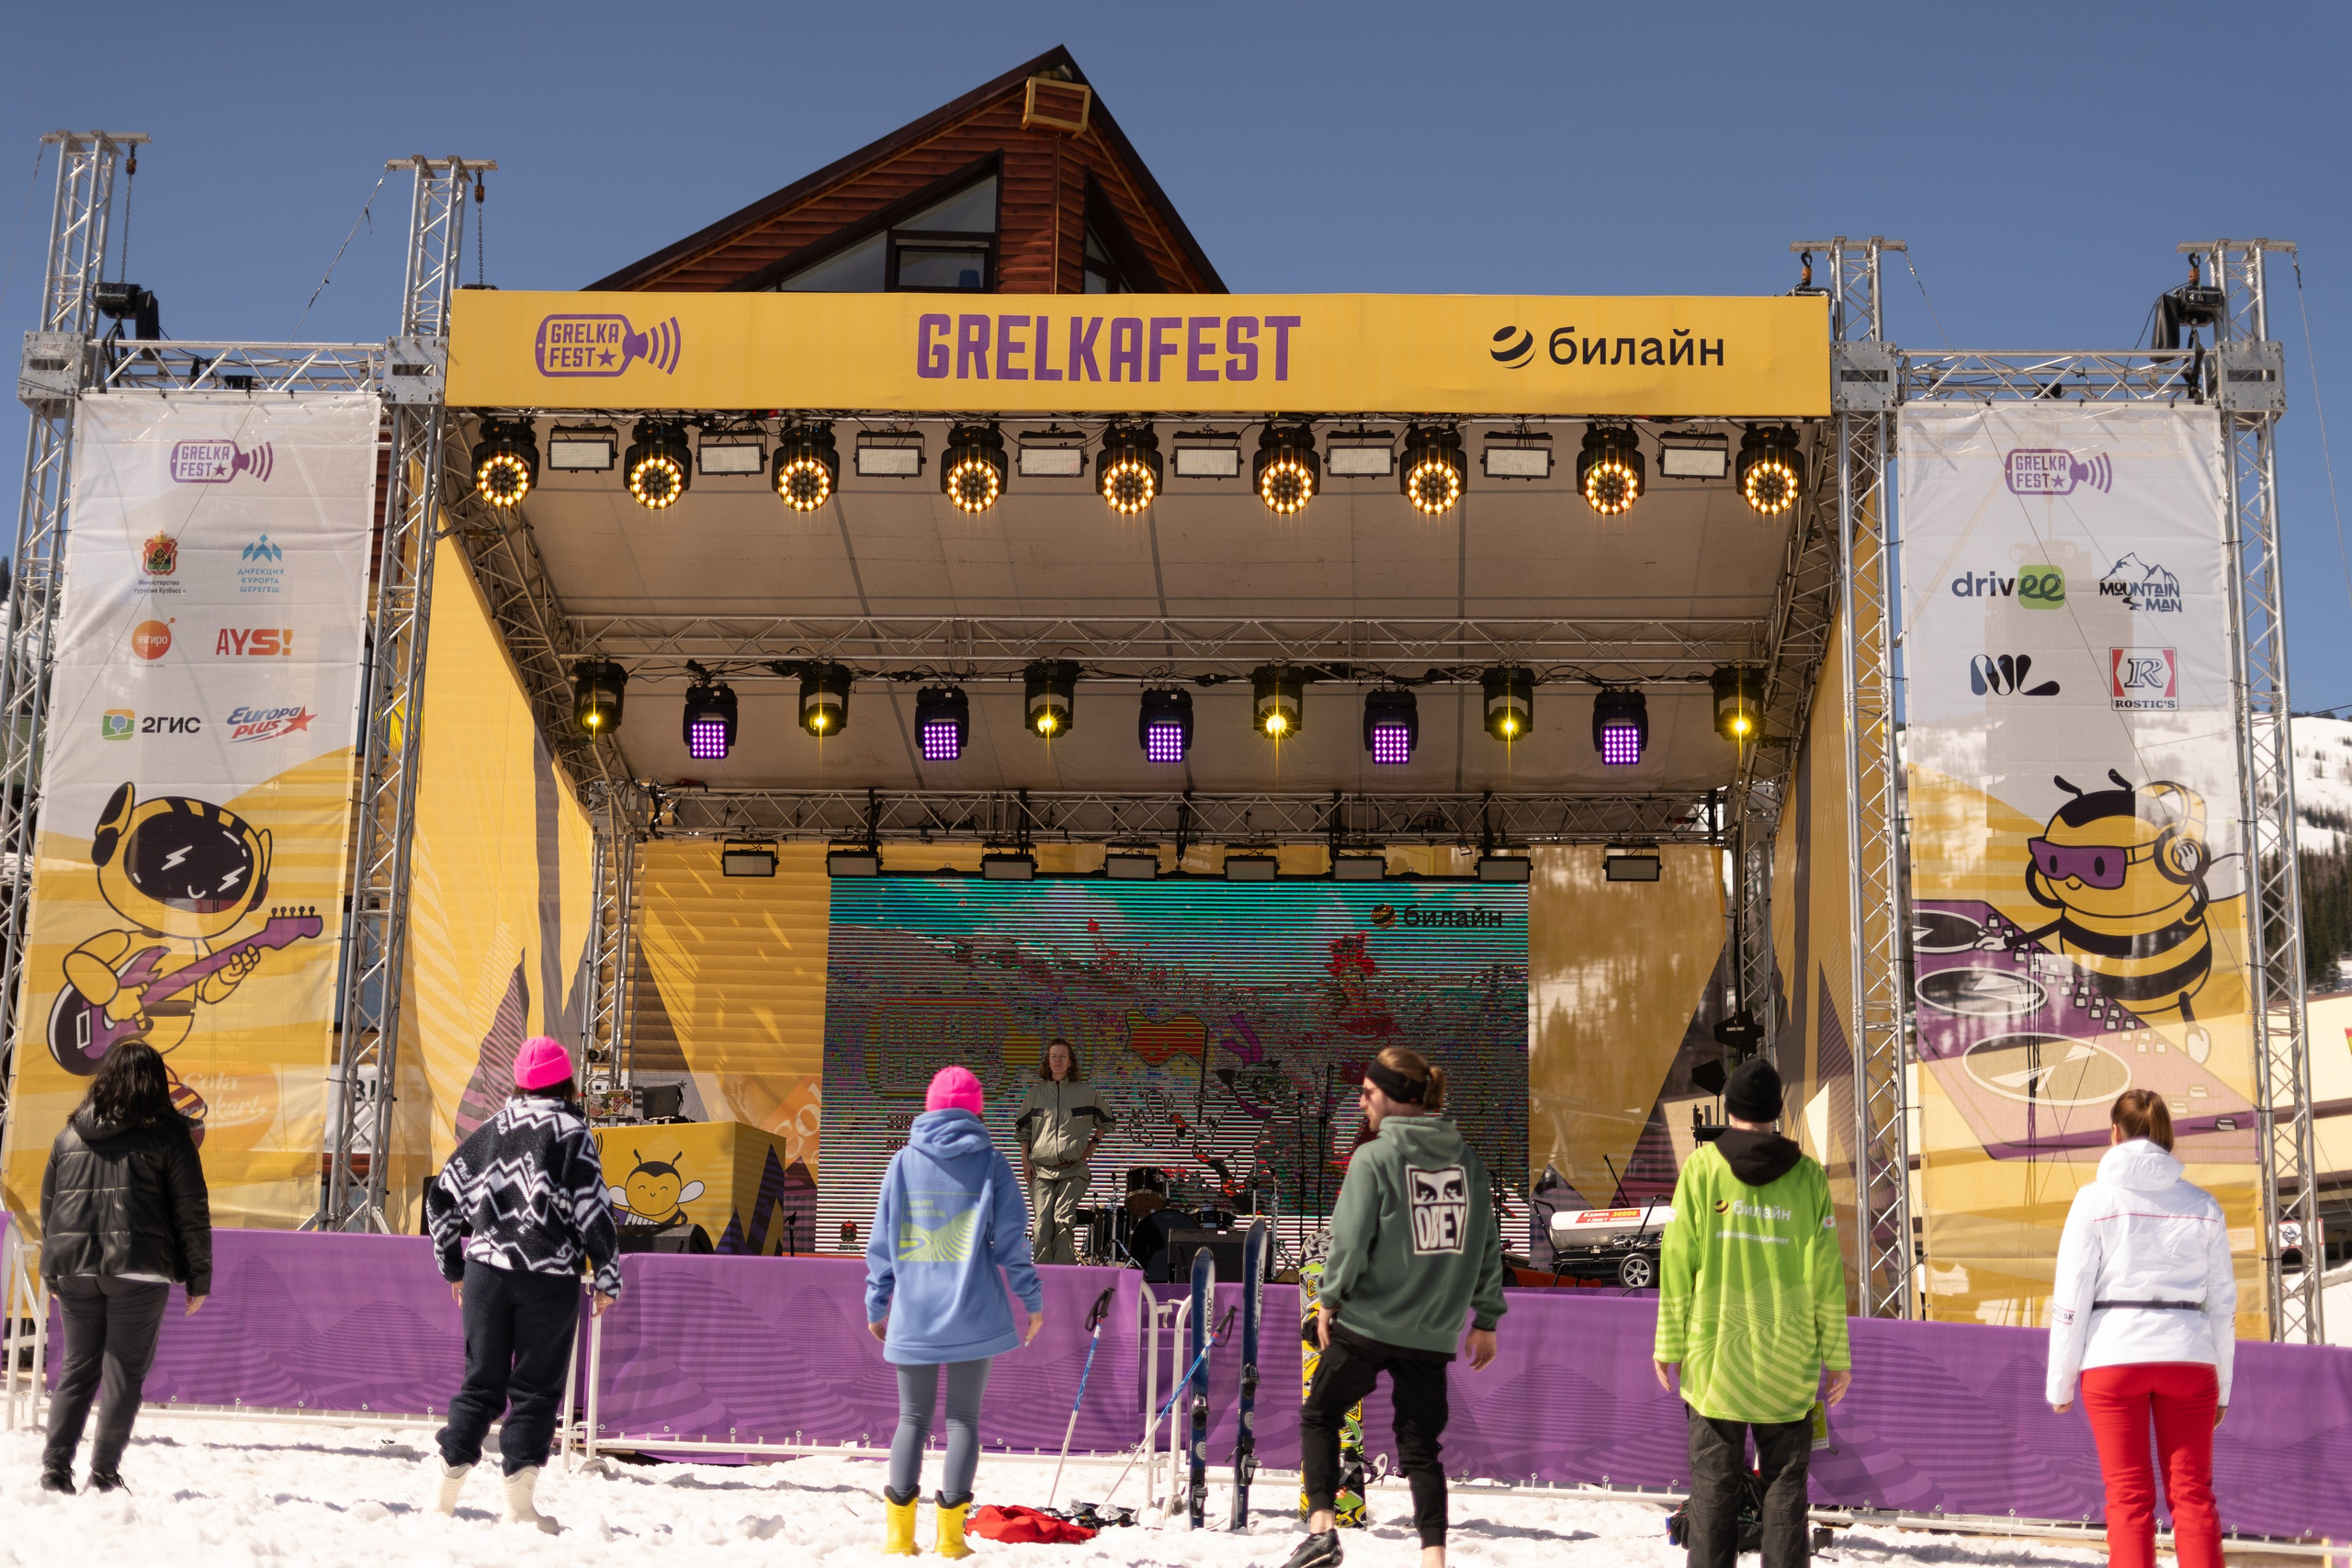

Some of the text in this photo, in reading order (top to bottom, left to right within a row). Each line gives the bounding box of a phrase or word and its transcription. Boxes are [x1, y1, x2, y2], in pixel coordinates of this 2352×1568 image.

[550, 323, 619, 344] GRELKA
[917, 313, 1301, 382] GRELKAFEST
[1548, 325, 1724, 366] билайн
[549, 347, 597, 367] FEST
[181, 446, 230, 460] GRELKA
[180, 462, 213, 477] FEST
[2016, 456, 2066, 470] GRELKA
[2017, 473, 2050, 488] FEST
[237, 568, 284, 576] ДИРЕКЦИЯ
[138, 579, 180, 587] Министерство
[1951, 570, 2065, 602] drivee
[2099, 581, 2180, 598] MOUNTAIN
[2145, 598, 2183, 614] MAN
[136, 635, 168, 646] энгиро
[215, 628, 294, 656] AYS!
[2115, 700, 2176, 708] ROSTIC'S
[141, 716, 201, 734] 2ГИС
[1403, 904, 1502, 928] билайн
[1733, 1199, 1792, 1221] билайн
[1415, 1205, 1466, 1249] OBEY
